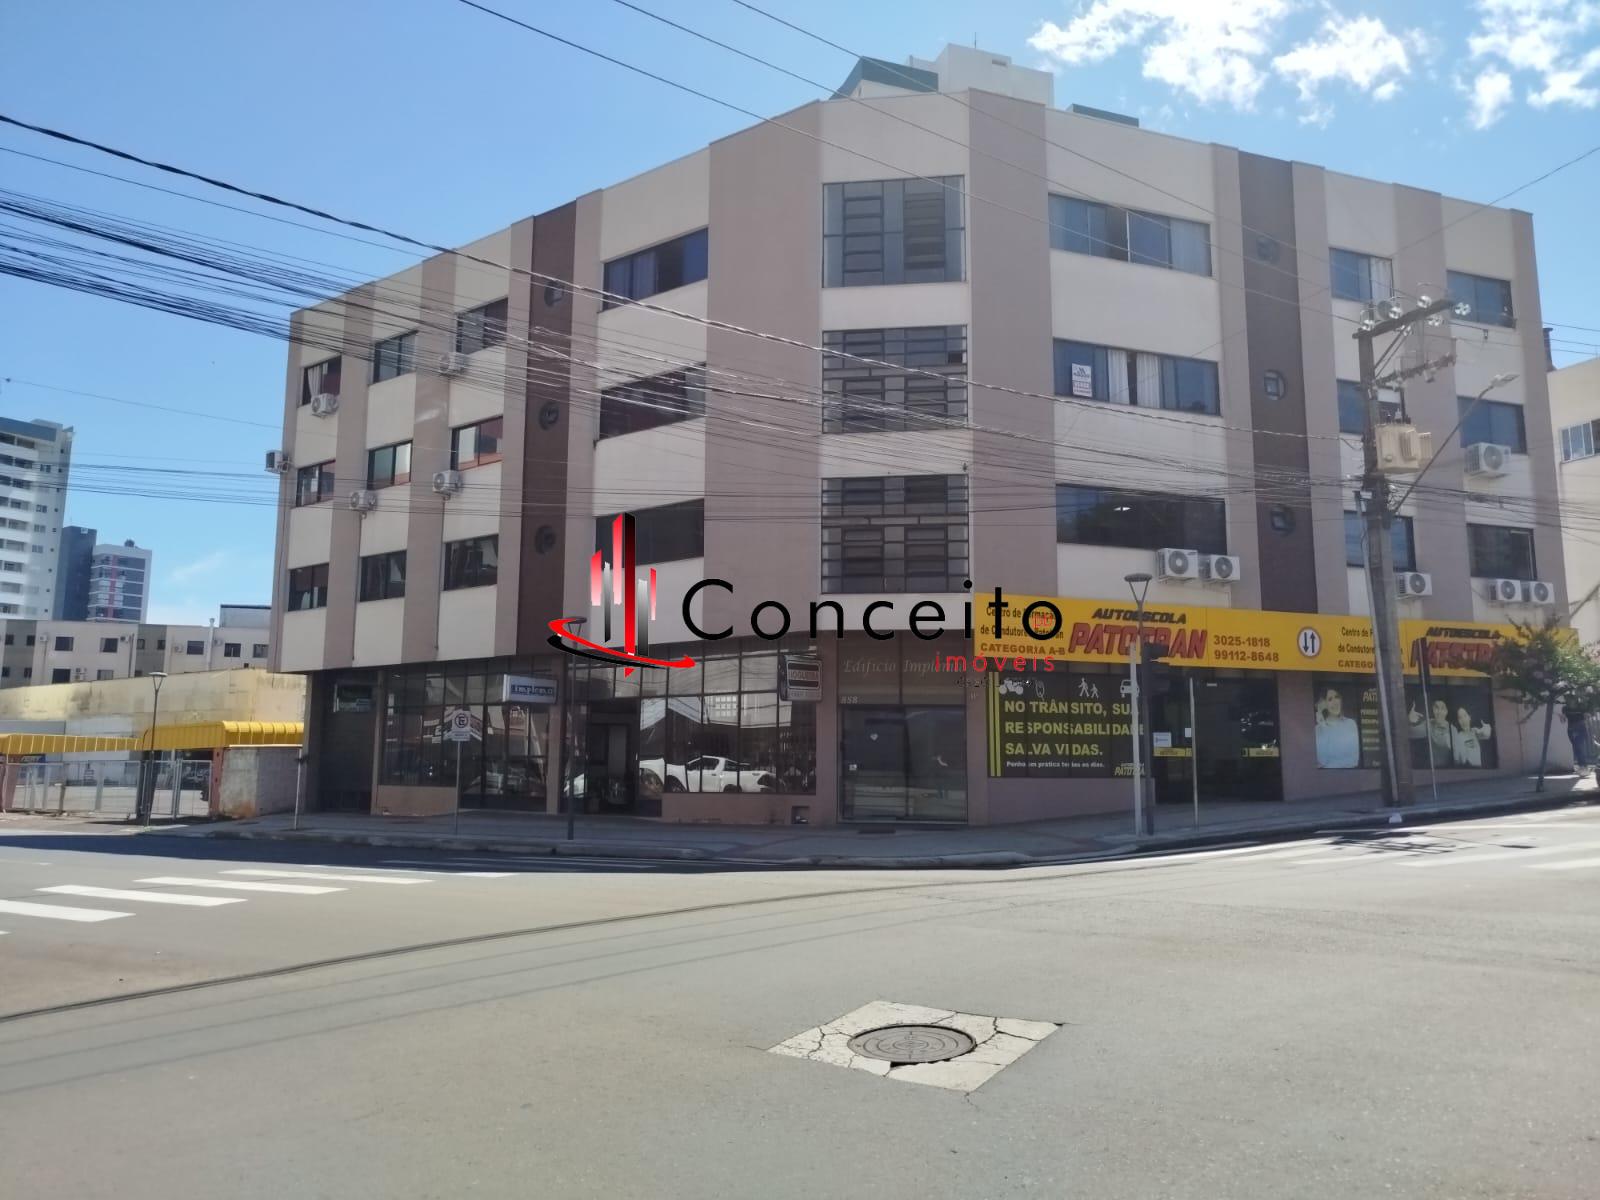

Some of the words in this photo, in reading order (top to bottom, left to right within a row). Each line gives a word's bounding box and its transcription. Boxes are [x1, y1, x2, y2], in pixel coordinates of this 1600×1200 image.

[986, 607, 1011, 618] Cetro
[991, 625, 1029, 637] Cndutore
[1214, 634, 1271, 648] 3025-1818
[980, 643, 1045, 655] CATEGORIA
[1346, 643, 1377, 654] Condutore
[1214, 650, 1279, 662] 99112-8648
[1338, 660, 1376, 669] CATEGO
[1004, 700, 1025, 713] NO
[1112, 703, 1139, 715] SU
[1005, 721, 1144, 736] RESPONSABILIDA
